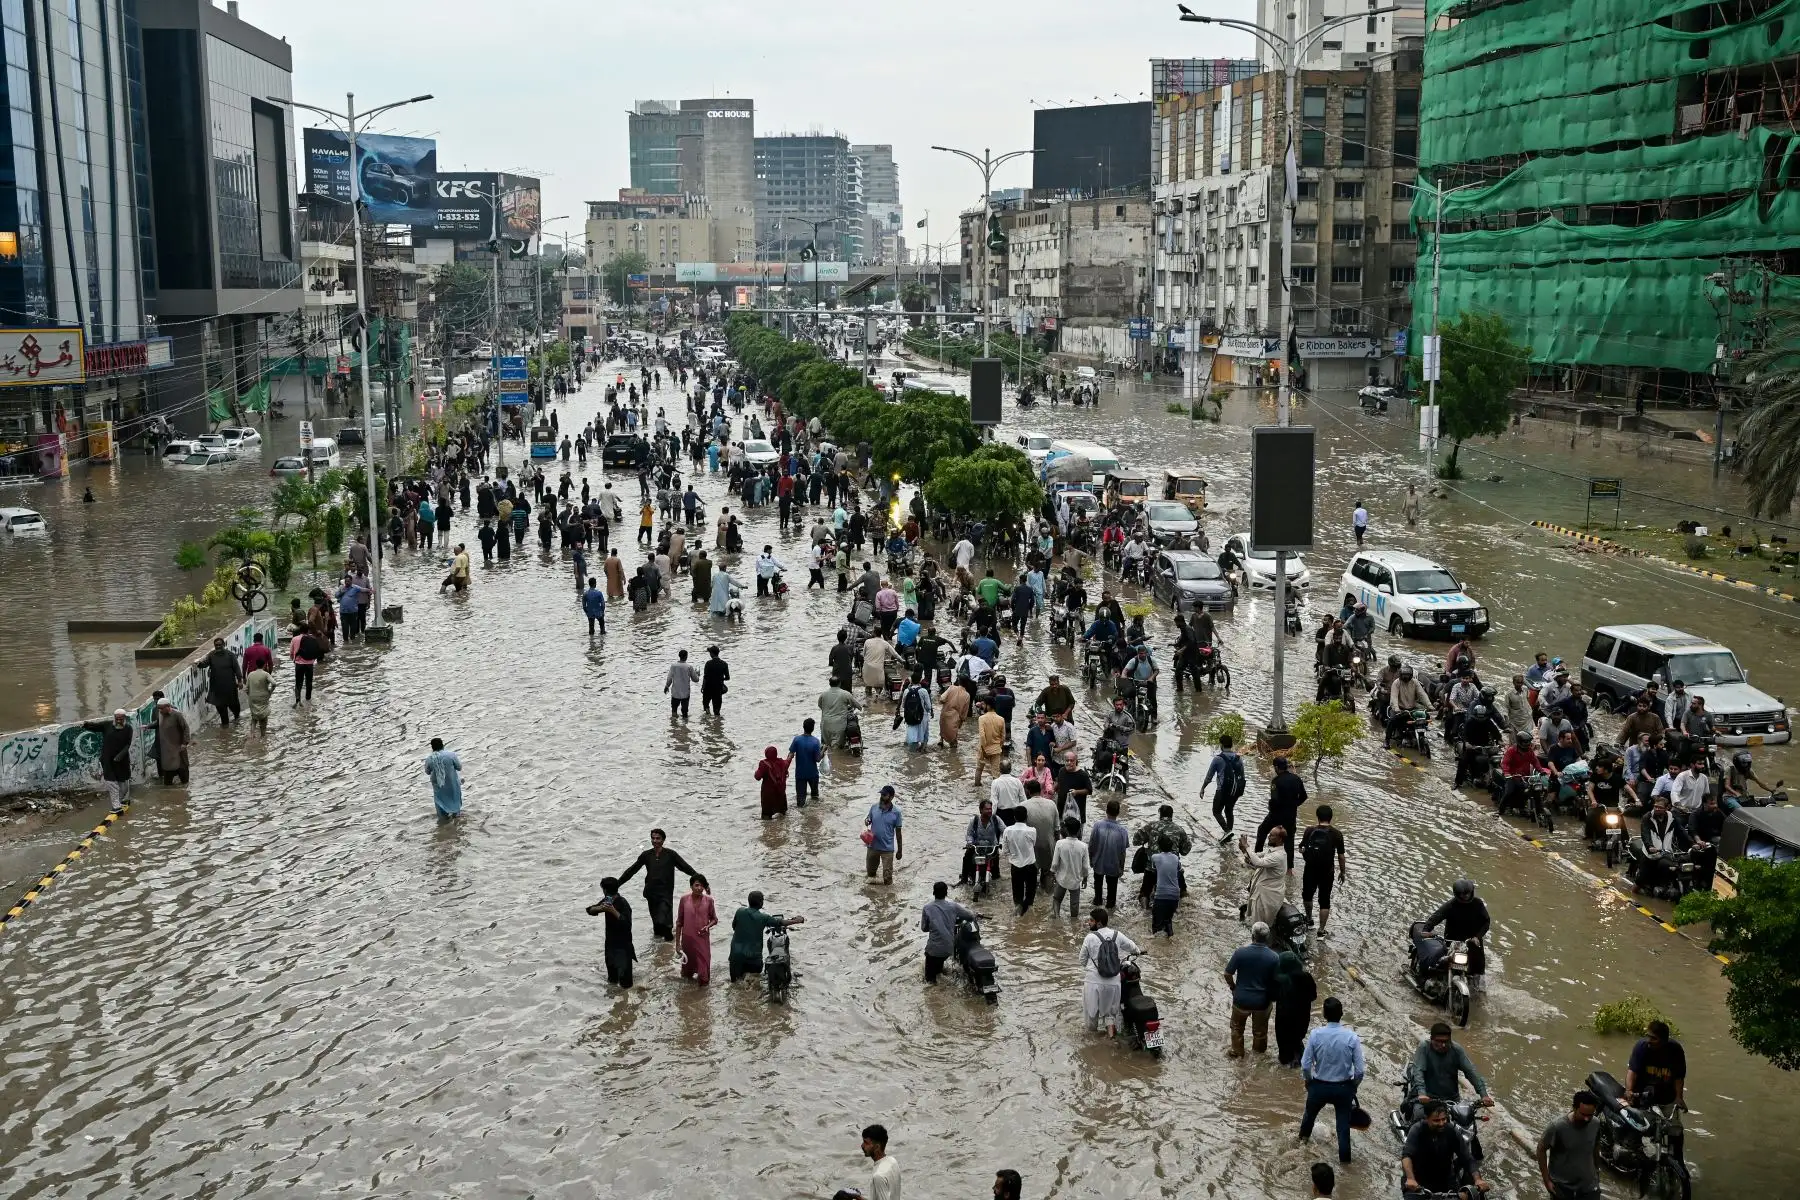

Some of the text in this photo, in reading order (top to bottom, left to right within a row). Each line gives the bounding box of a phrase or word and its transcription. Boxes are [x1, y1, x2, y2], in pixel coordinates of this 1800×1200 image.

[707, 110, 750, 118] CDC HOUSE
[437, 181, 481, 198] KFC
[1306, 341, 1336, 351] Ribbon
[1338, 340, 1366, 350] Bakers
[1417, 594, 1465, 604] UN
